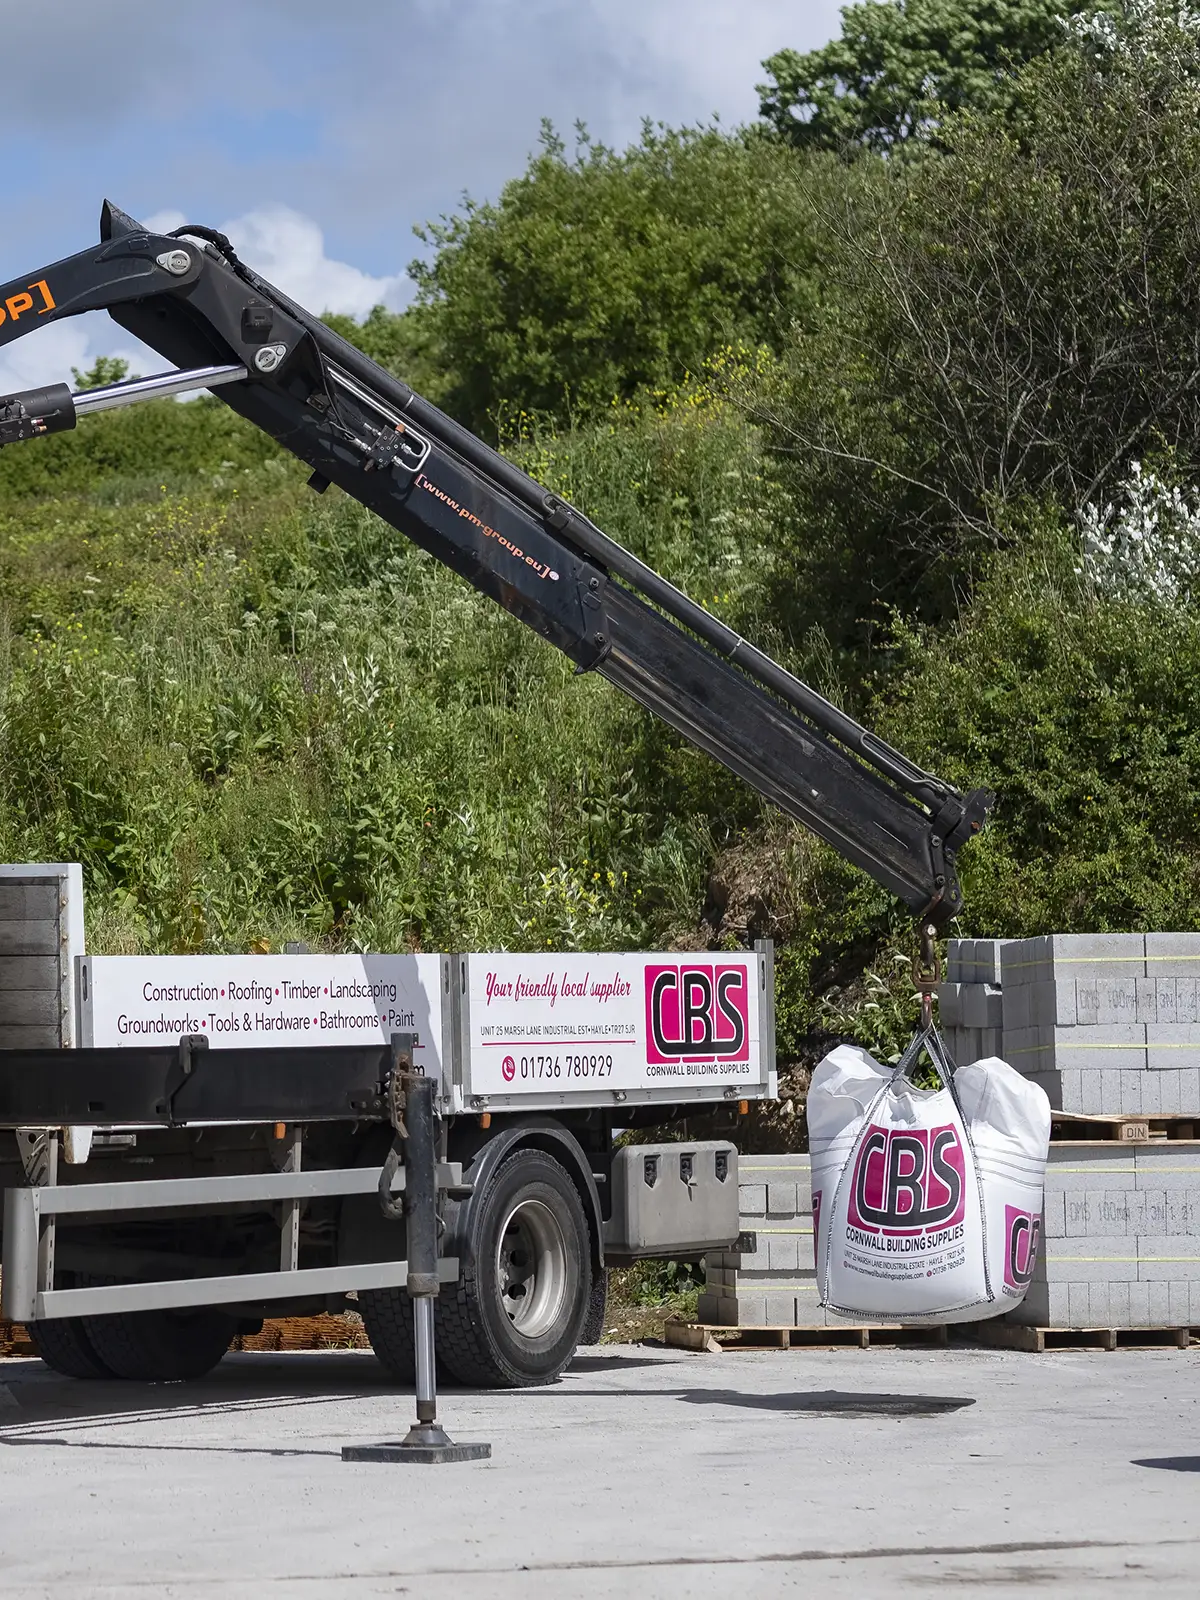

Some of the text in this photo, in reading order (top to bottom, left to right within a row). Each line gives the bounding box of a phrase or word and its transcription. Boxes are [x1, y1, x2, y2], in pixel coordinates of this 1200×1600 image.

[143, 977, 397, 1005] Construction Roofing Timber Landscaping
[486, 972, 631, 1007] Your friendly local supplier
[117, 1008, 415, 1034] Groundworks Tools & Hardware Bathrooms Paint
[652, 971, 744, 1058] CBS
[480, 1026, 495, 1036] UNIT
[496, 1026, 504, 1036] 25
[504, 1025, 525, 1036] MARSH
[526, 1025, 542, 1036] LANE
[542, 1024, 576, 1036] INDUSTRIAL
[625, 1024, 635, 1034] 5JR
[520, 1055, 613, 1079] 01736 780929
[646, 1063, 750, 1077] CORNWALL BUILDING SUPPLIES
[1126, 1127, 1145, 1138] DIN
[857, 1130, 963, 1227] CBS
[846, 1224, 964, 1252] CORNWALL BUILDING SUPPLIES
[871, 1259, 883, 1269] LANE
[882, 1261, 908, 1270] INDUSTRIAL
[909, 1260, 925, 1270] ESTATE
[928, 1256, 943, 1267] HAYLE
[932, 1264, 947, 1275] 01736
[947, 1256, 966, 1270] 780929
